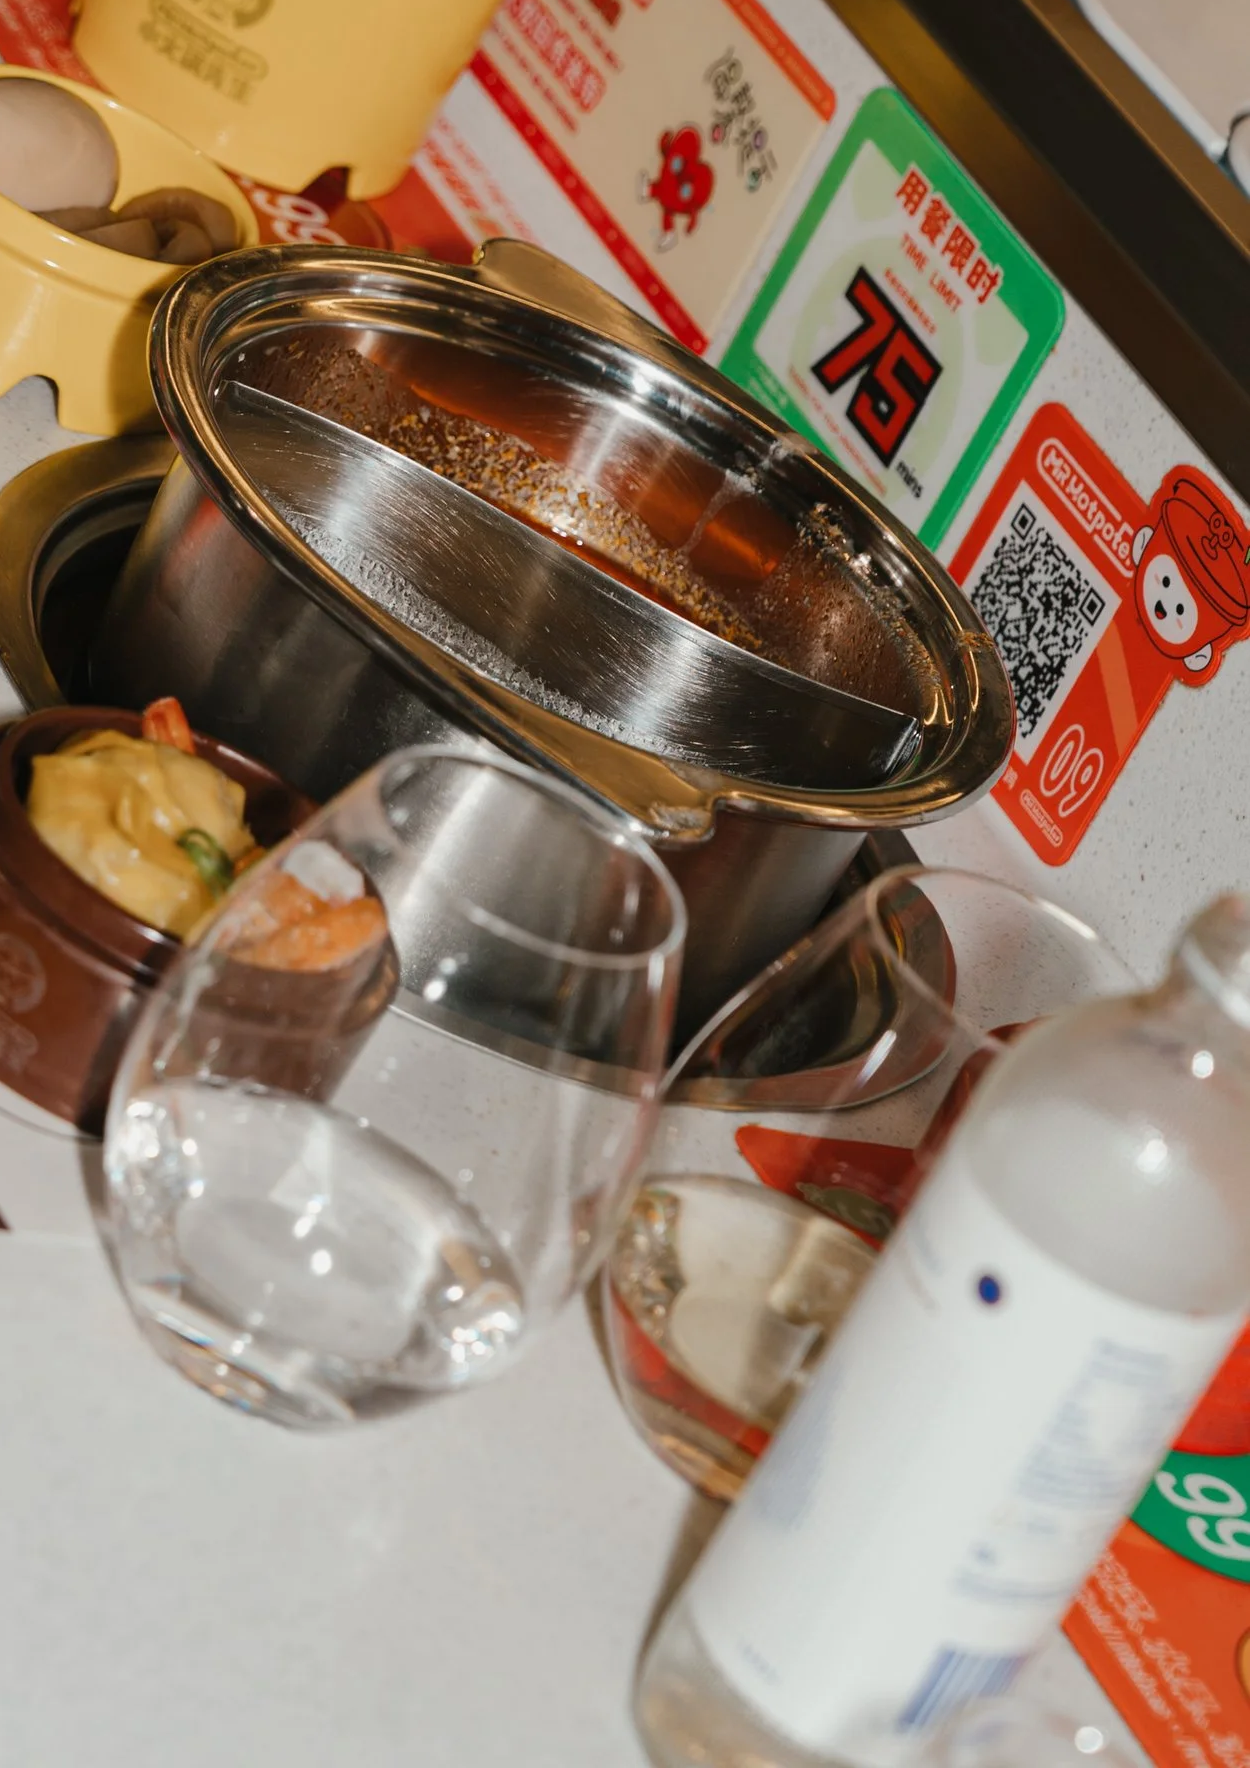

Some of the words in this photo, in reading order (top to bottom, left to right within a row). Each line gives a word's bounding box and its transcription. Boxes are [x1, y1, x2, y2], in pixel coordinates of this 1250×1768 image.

[893, 167, 1004, 307] 用餐限时
[897, 232, 930, 275] TIME
[927, 269, 963, 316] LIMIT
[810, 265, 944, 468] 75
[895, 460, 924, 502] mins
[1041, 726, 1103, 816] 09
